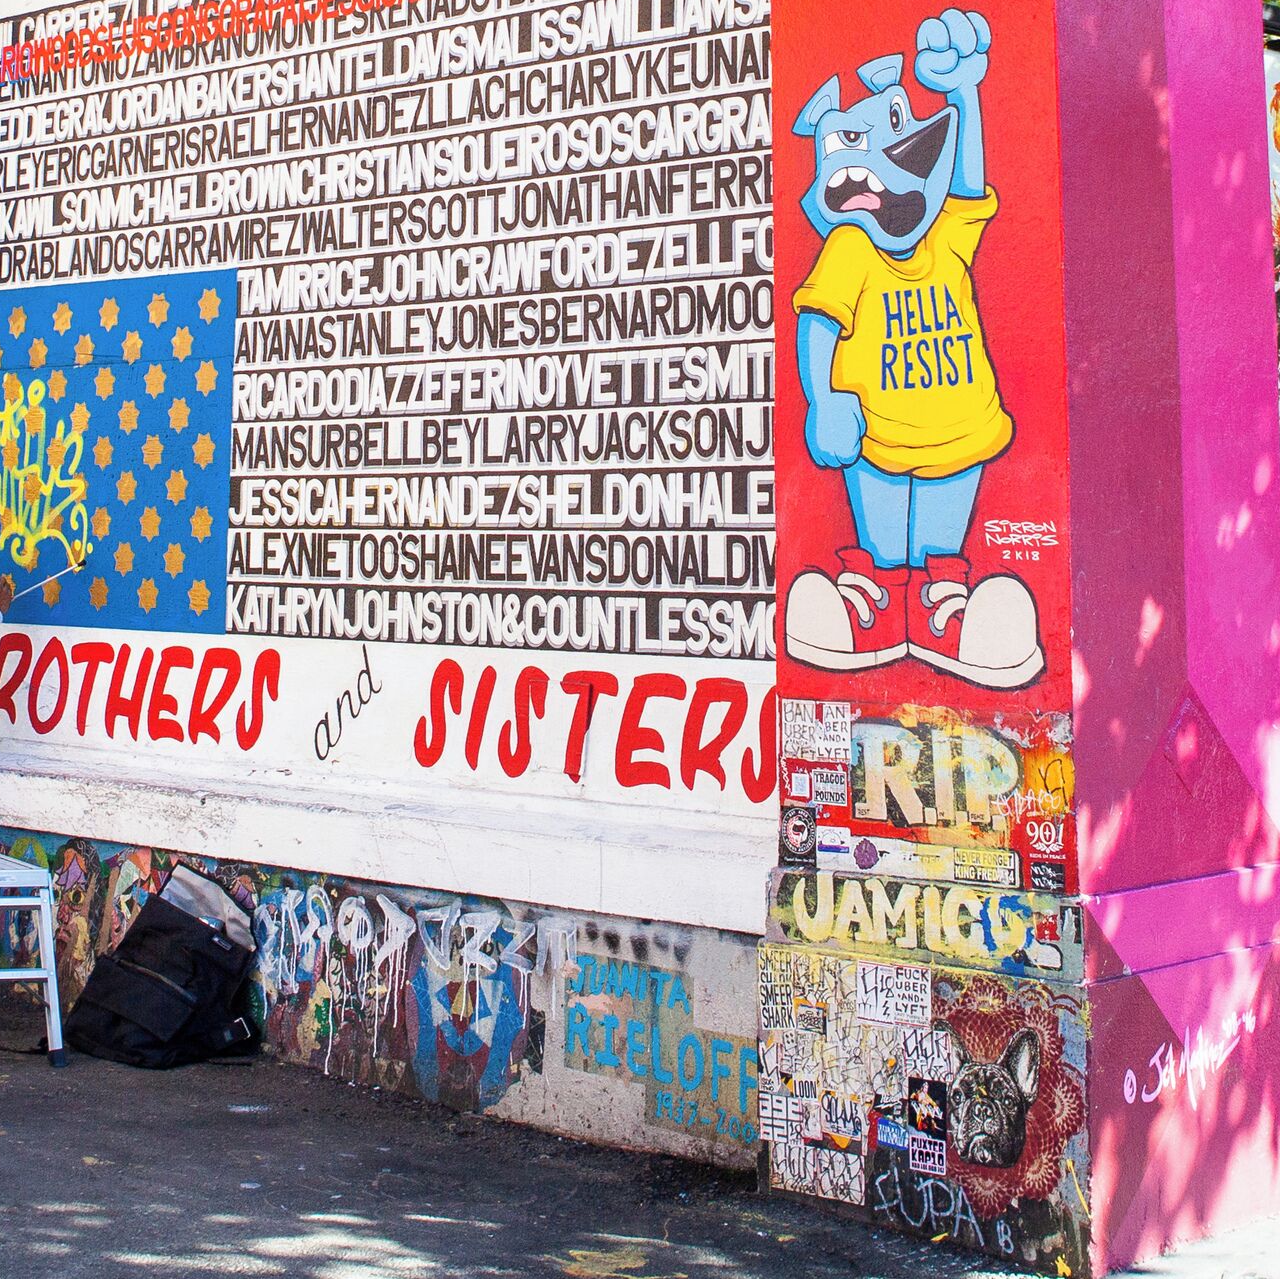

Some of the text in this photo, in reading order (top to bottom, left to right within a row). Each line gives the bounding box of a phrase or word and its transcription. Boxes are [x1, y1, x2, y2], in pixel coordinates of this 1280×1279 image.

[881, 282, 963, 339] HELLA
[880, 332, 974, 391] RESIST
[313, 644, 383, 761] and
[814, 790, 846, 802] POUNDS
[570, 953, 691, 1016] JUANITA
[895, 967, 929, 983] FUCK
[761, 984, 793, 1006] SMEER
[895, 982, 928, 995] UBER
[762, 1007, 796, 1029] SHARK
[894, 1001, 928, 1017] LYFT
[565, 1002, 758, 1115] RIELOFF
[793, 1080, 818, 1099] LOON
